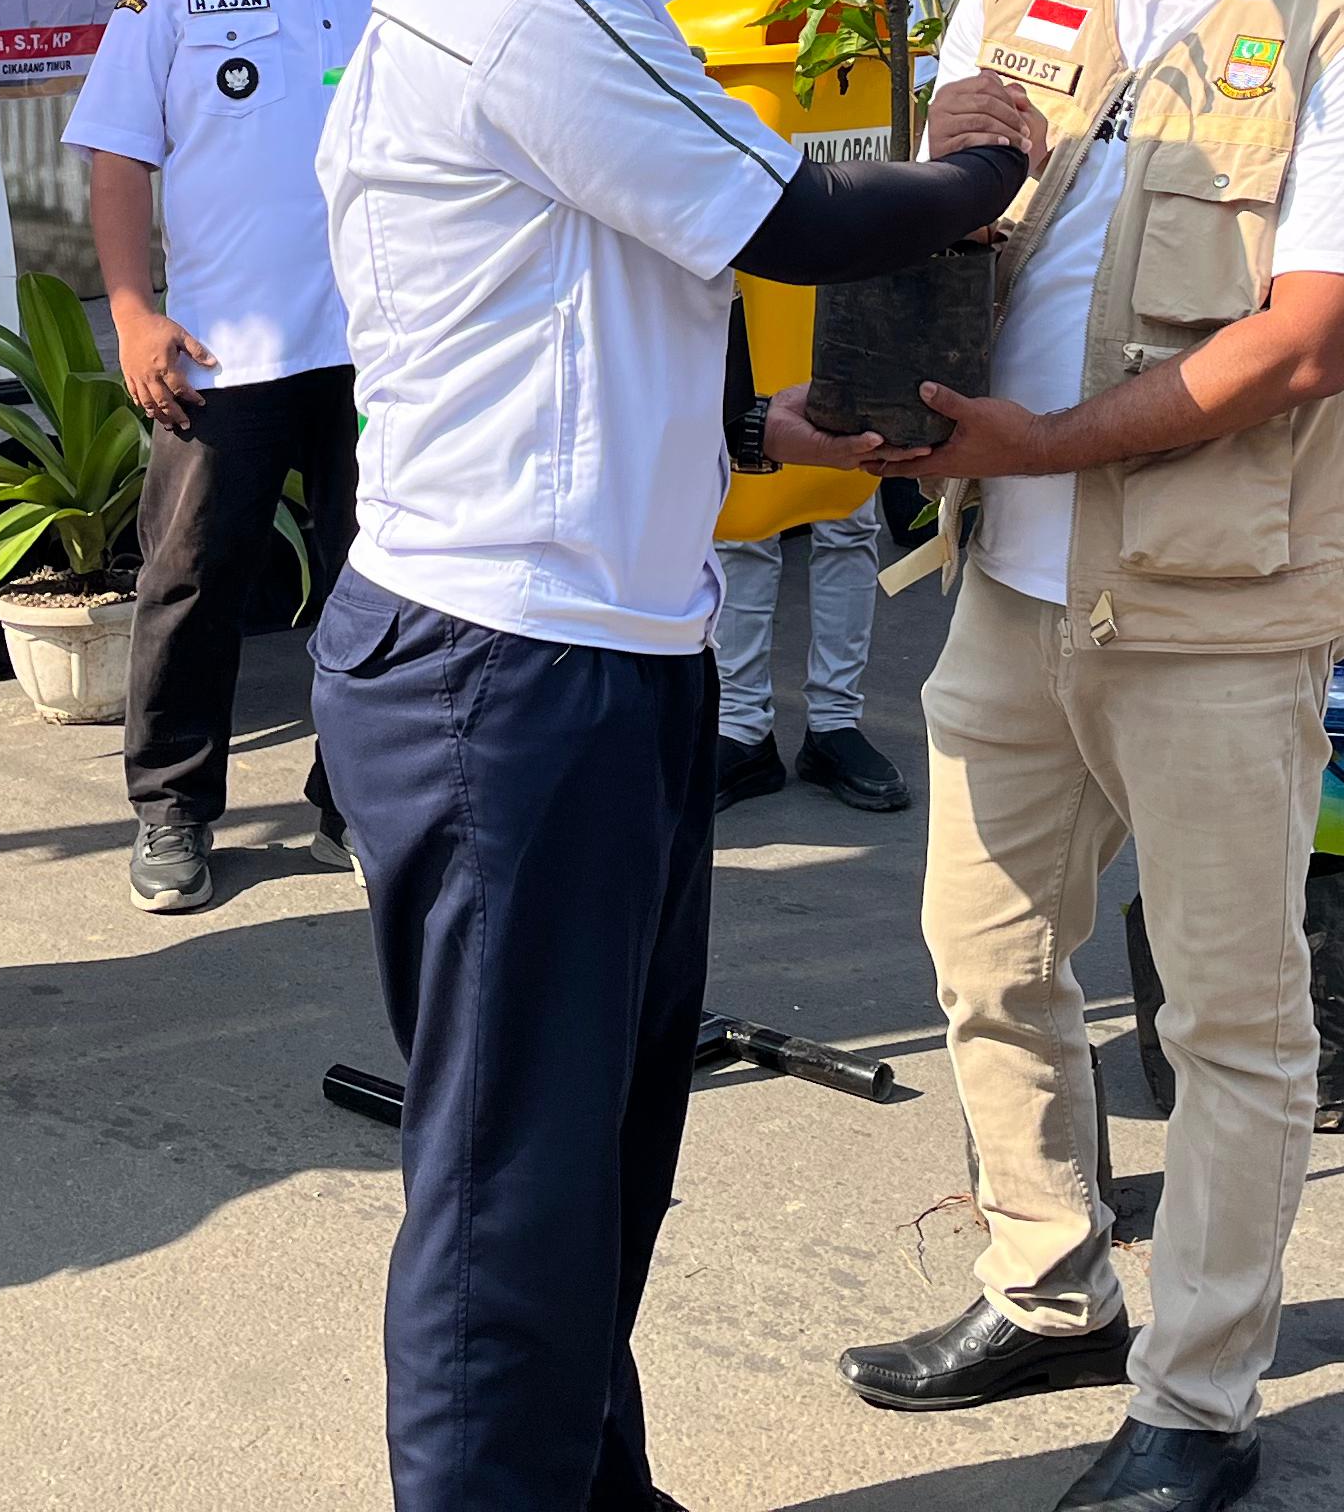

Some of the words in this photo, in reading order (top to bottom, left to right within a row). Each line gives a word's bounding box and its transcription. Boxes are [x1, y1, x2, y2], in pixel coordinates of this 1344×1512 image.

[14, 34, 49, 52] S.T.,
[53, 32, 72, 48] KP
[2, 61, 44, 75] CIKARANG
[46, 59, 72, 71] TIMUR
[803, 138, 837, 163] NON
[841, 134, 891, 162] ORGAN
